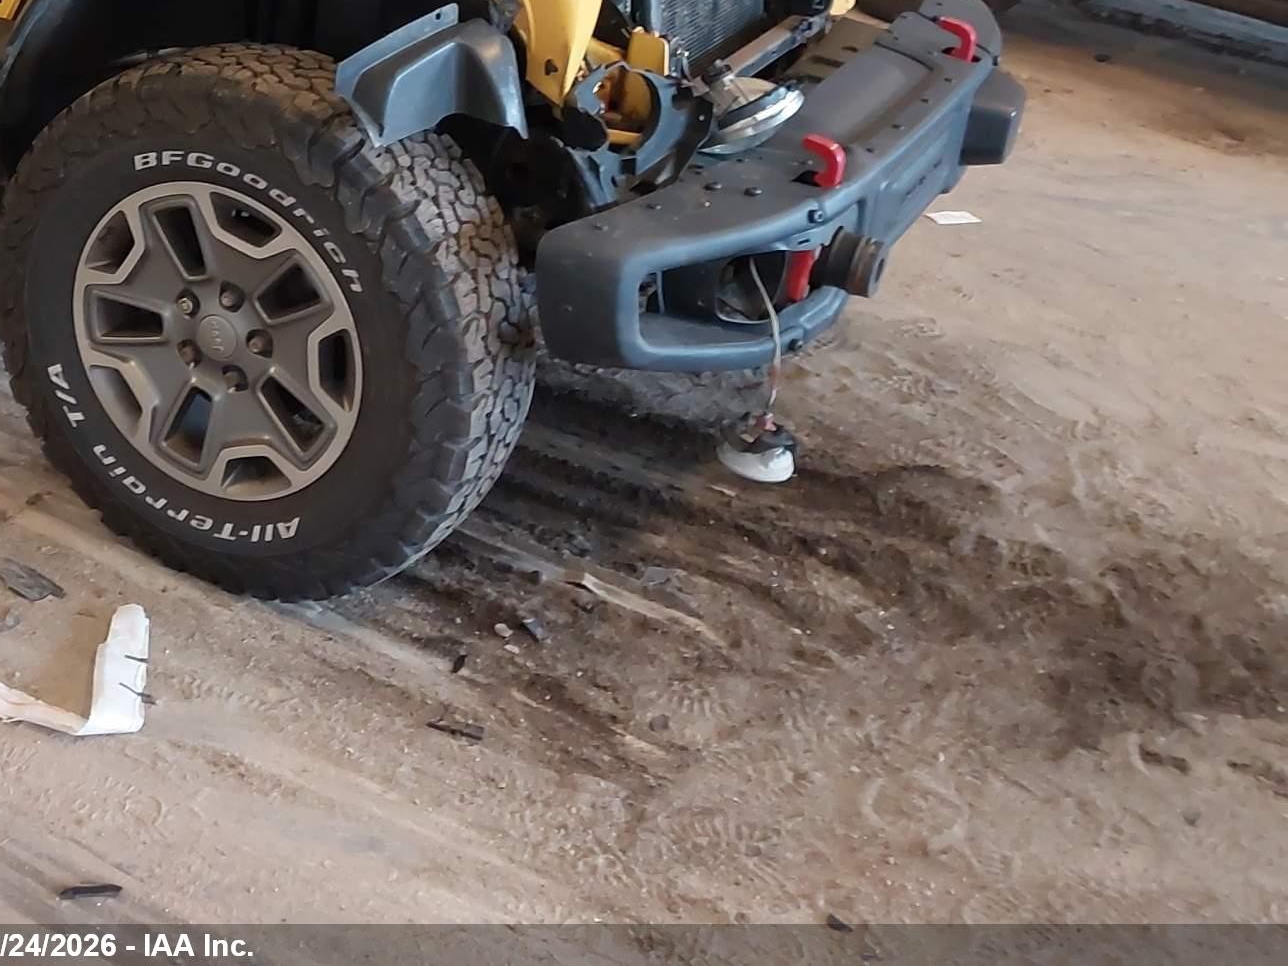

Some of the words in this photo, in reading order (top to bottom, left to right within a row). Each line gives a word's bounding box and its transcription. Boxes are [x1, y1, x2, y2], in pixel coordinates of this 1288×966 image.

[133, 150, 362, 292] BFGoodrich
[47, 363, 86, 428] T/A
[92, 444, 300, 542] All-Terrain
